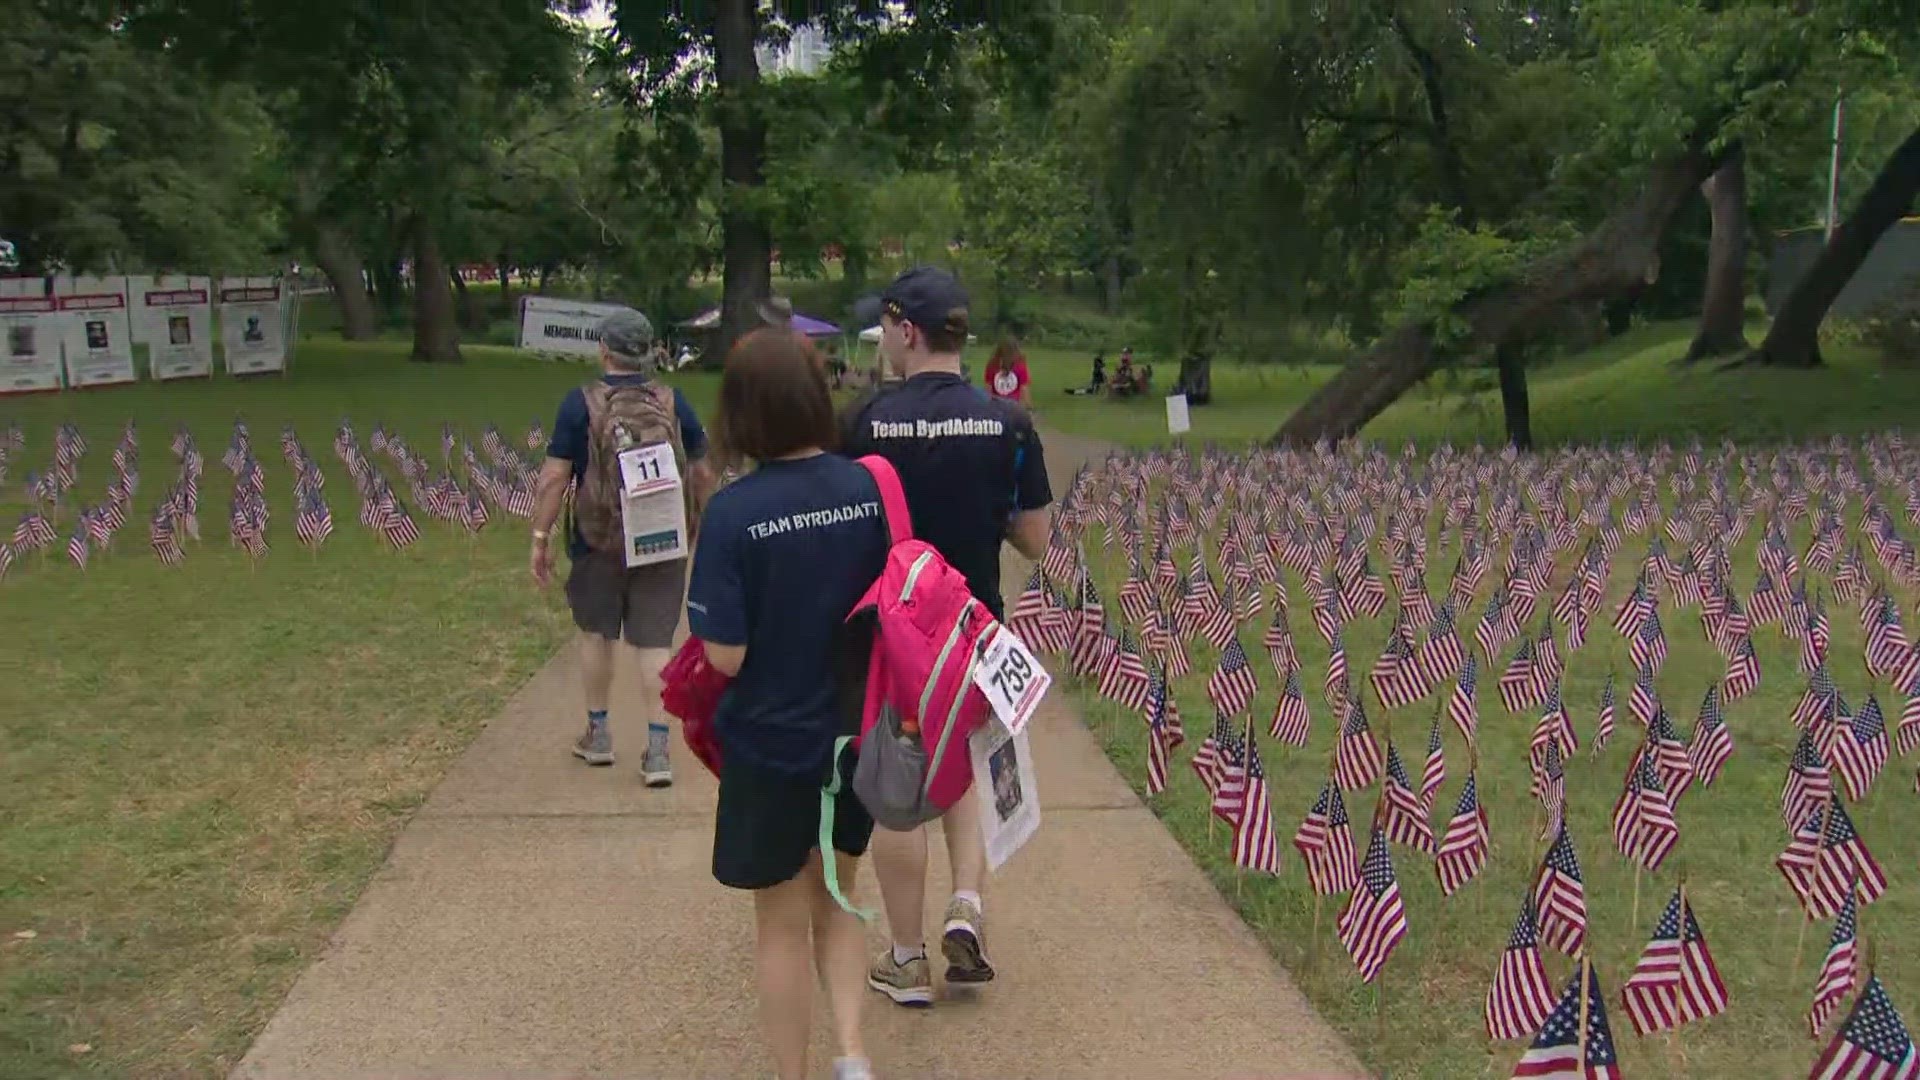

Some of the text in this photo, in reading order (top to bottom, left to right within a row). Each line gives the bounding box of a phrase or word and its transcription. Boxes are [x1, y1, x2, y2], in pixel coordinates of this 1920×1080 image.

[871, 417, 1004, 439] Team ByrdAdatto
[638, 457, 661, 480] 11
[747, 516, 791, 540] TEAM
[991, 646, 1032, 708] 759
